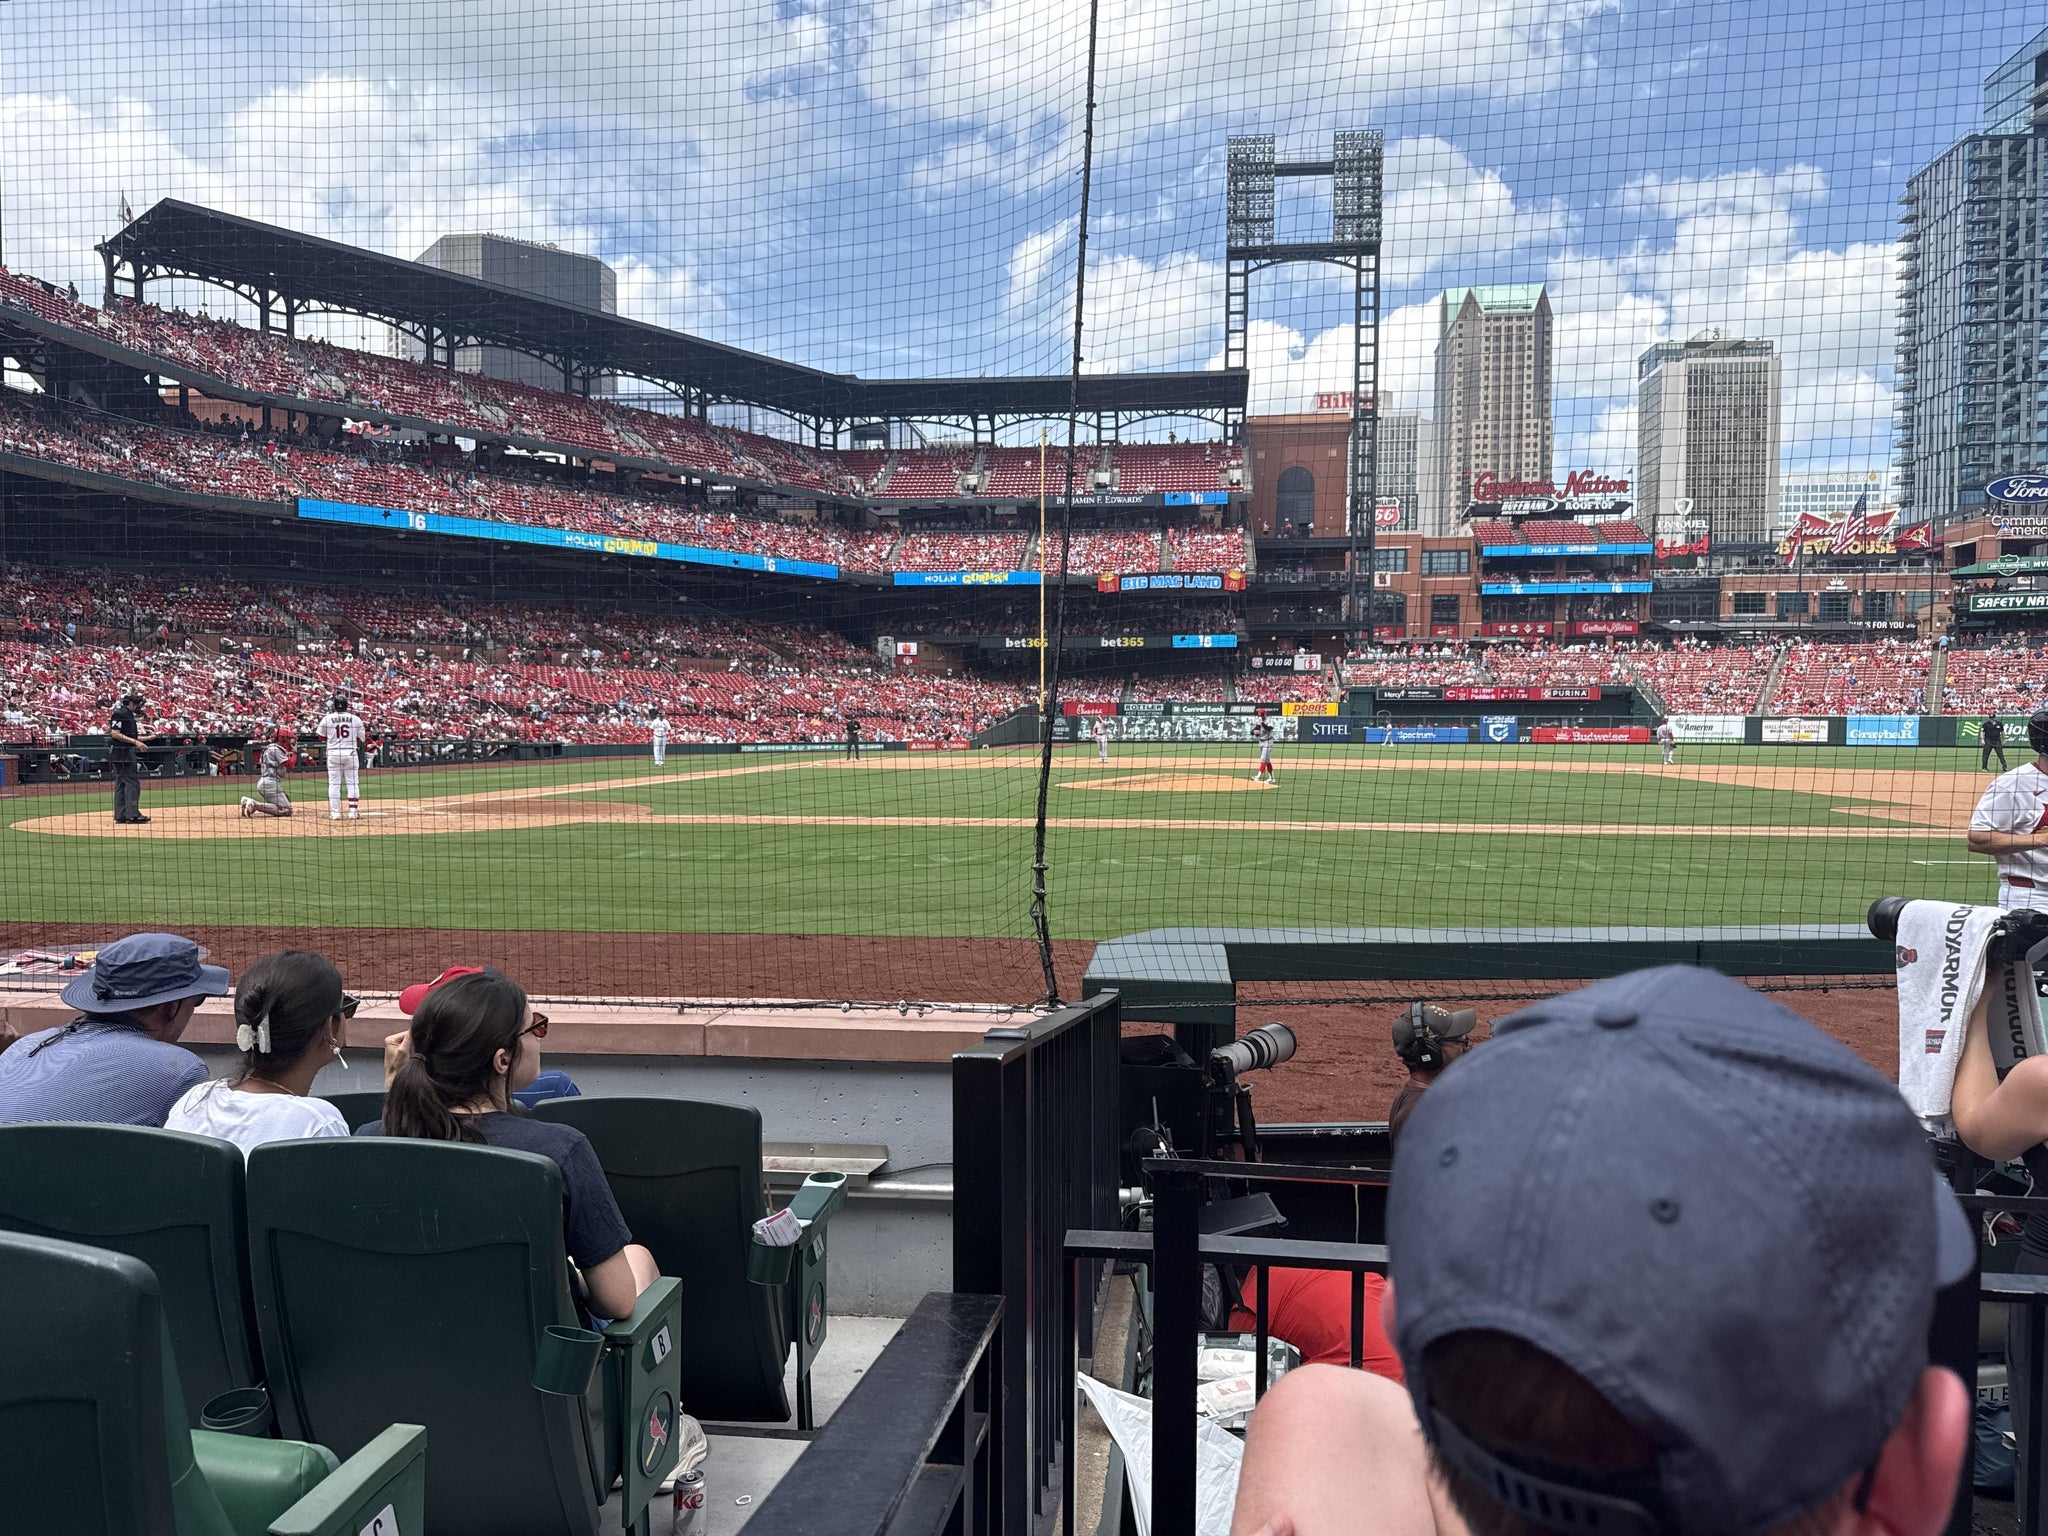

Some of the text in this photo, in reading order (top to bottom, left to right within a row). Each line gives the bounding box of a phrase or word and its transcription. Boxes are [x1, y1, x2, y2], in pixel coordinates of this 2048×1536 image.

[1474, 469, 1629, 500] Cardinals Nation
[1057, 496, 1095, 505] BEJAMIN
[1105, 495, 1142, 504] EDWARDS
[1191, 493, 1203, 504] 16
[1502, 500, 1616, 510] HOFFMANN ROOFTOP
[408, 511, 426, 531] 16
[1657, 520, 1710, 529] FANDUEL
[565, 535, 601, 548] NOLAN
[763, 557, 776, 571] 16
[925, 575, 957, 583] NOLAN
[1121, 575, 1222, 590] BIG MAC LAND
[1976, 596, 2024, 608] SAFETY
[1872, 621, 1887, 629] FOR
[1889, 621, 1904, 629] YOU
[1101, 637, 1144, 647] bet365
[1198, 635, 1212, 648] 16
[1384, 690, 1400, 699] Mercy
[1553, 689, 1588, 697] PURINA
[1183, 705, 1225, 713] Central Bank
[1293, 704, 1328, 712] DOBBS
[111, 720, 122, 728] 74
[1482, 715, 1515, 723] CarShield
[335, 724, 350, 738] 16
[1312, 723, 1350, 735] STIFEL
[1397, 731, 1433, 739] Spectrum
[1573, 731, 1631, 741] Budweiser
[1941, 905, 1972, 1024] ODYARMOR
[658, 1333, 666, 1356] B
